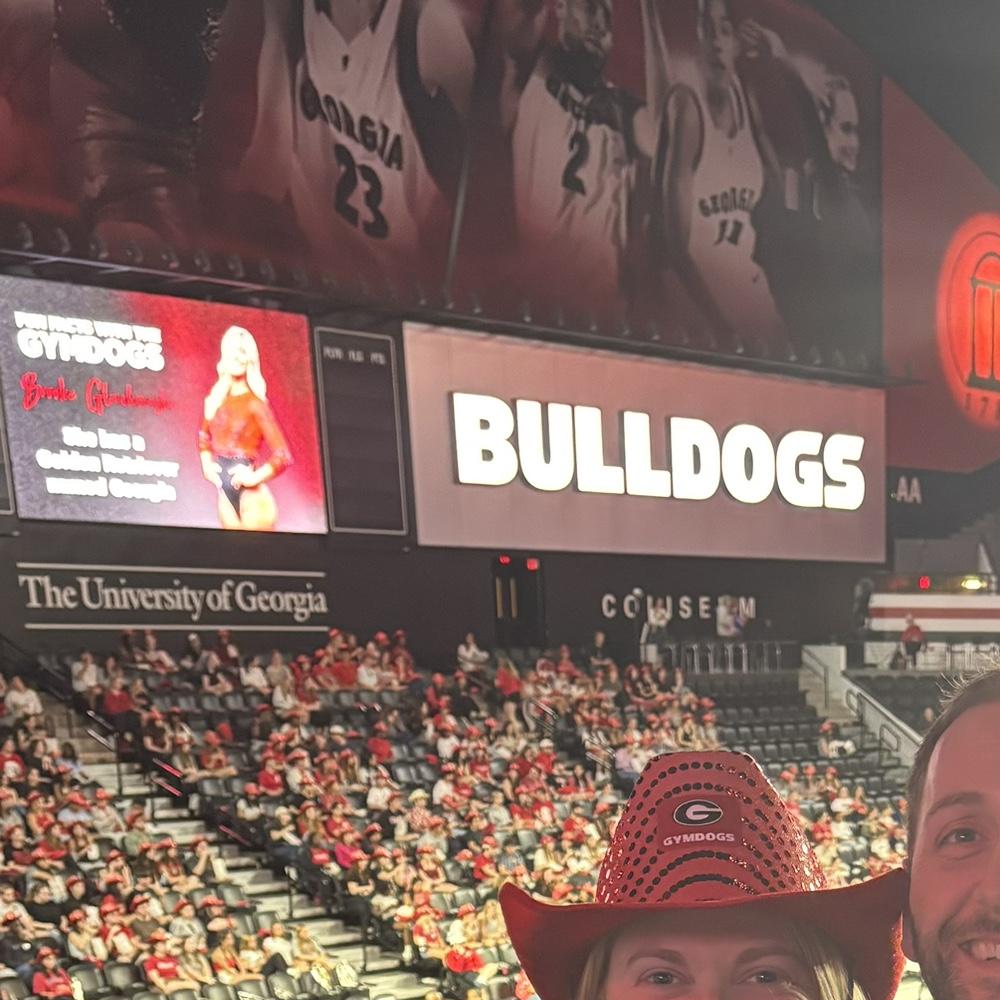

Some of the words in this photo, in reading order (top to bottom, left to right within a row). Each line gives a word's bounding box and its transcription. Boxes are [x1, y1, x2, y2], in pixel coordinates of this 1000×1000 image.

[301, 77, 403, 171] GORGIA
[562, 131, 590, 195] 2
[334, 143, 390, 239] 23
[17, 328, 165, 371] GYMDOGS
[452, 392, 866, 511] BULLDOGS
[896, 475, 922, 504] AA
[18, 575, 77, 608] The
[76, 576, 206, 620] University
[206, 580, 235, 611] of
[235, 581, 328, 622] Georgia
[663, 832, 735, 846] GYMDOGS
